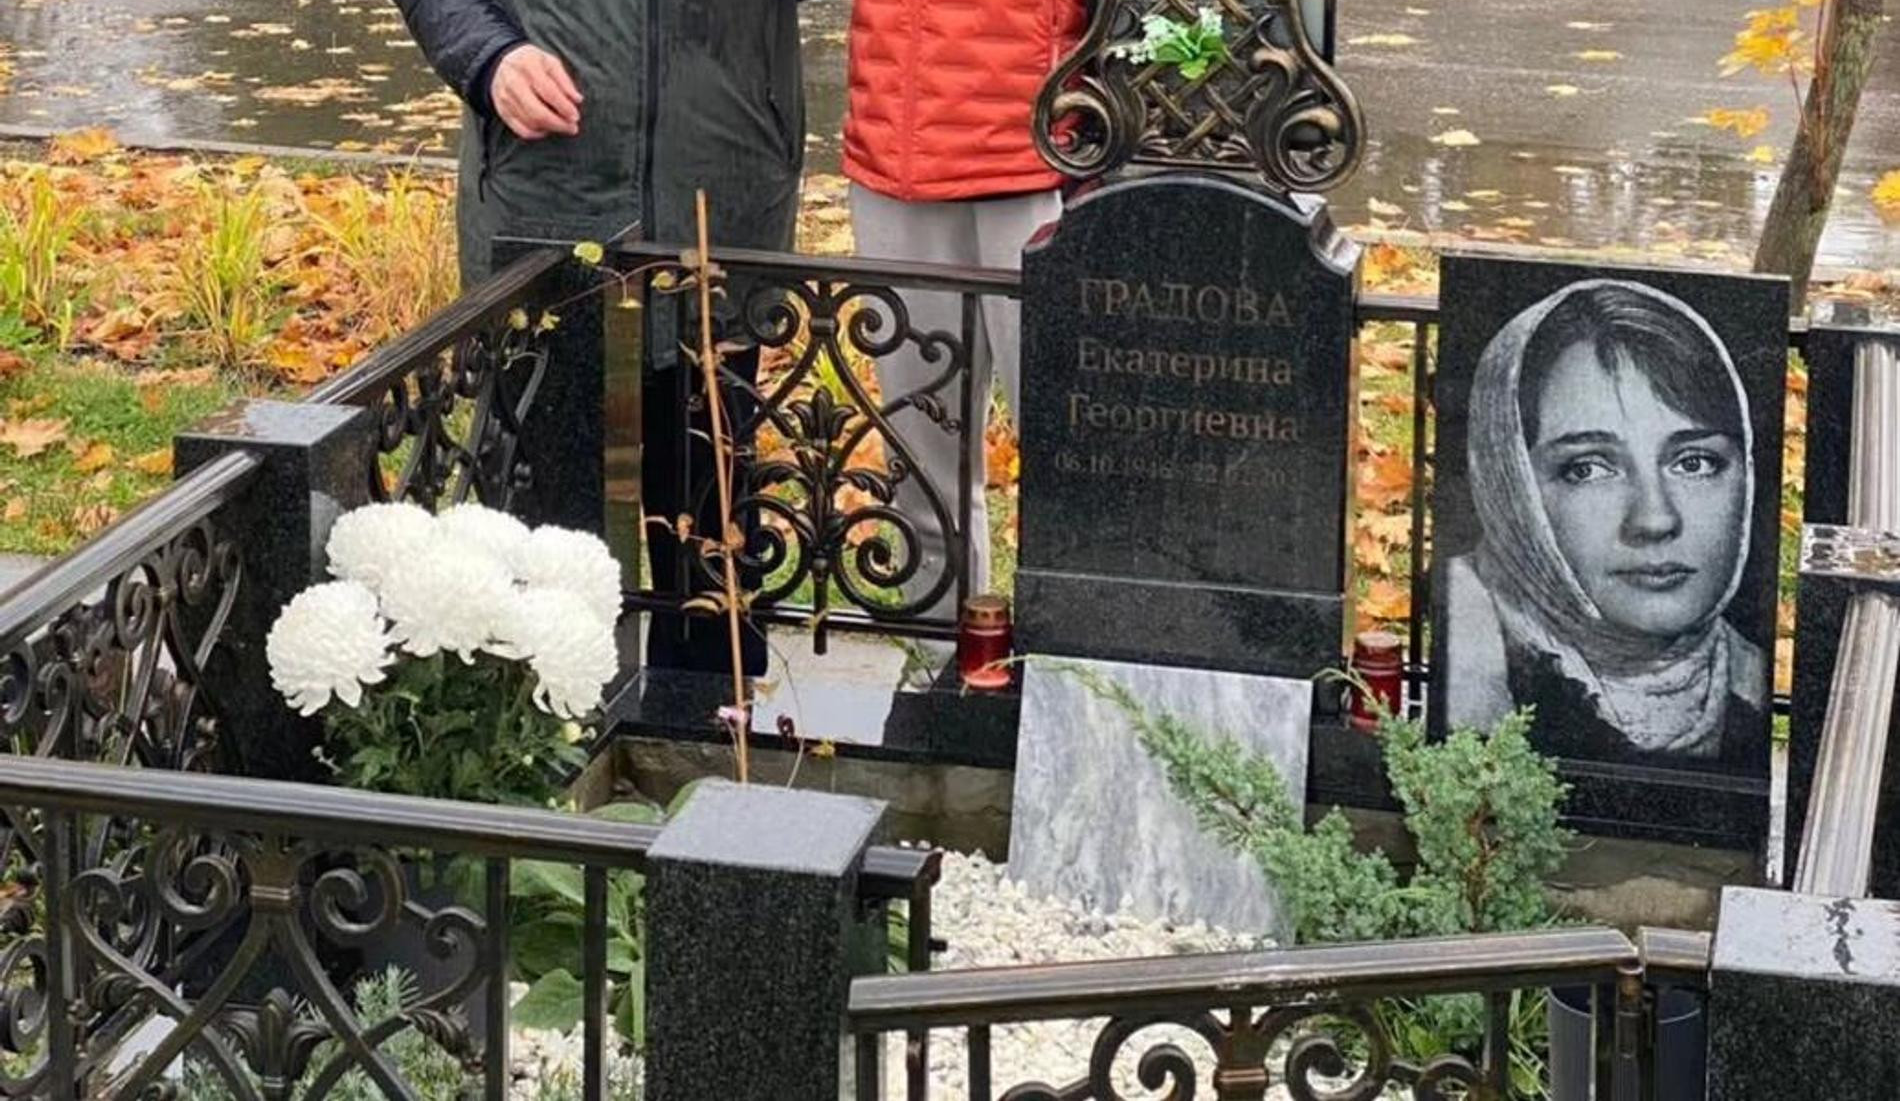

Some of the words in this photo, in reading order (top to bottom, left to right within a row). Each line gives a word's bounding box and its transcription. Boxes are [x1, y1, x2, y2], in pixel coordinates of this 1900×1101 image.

[1077, 278, 1295, 327] ГРАДОВА
[1077, 337, 1292, 387] Екатерина
[1067, 392, 1299, 442] Георгиевна
